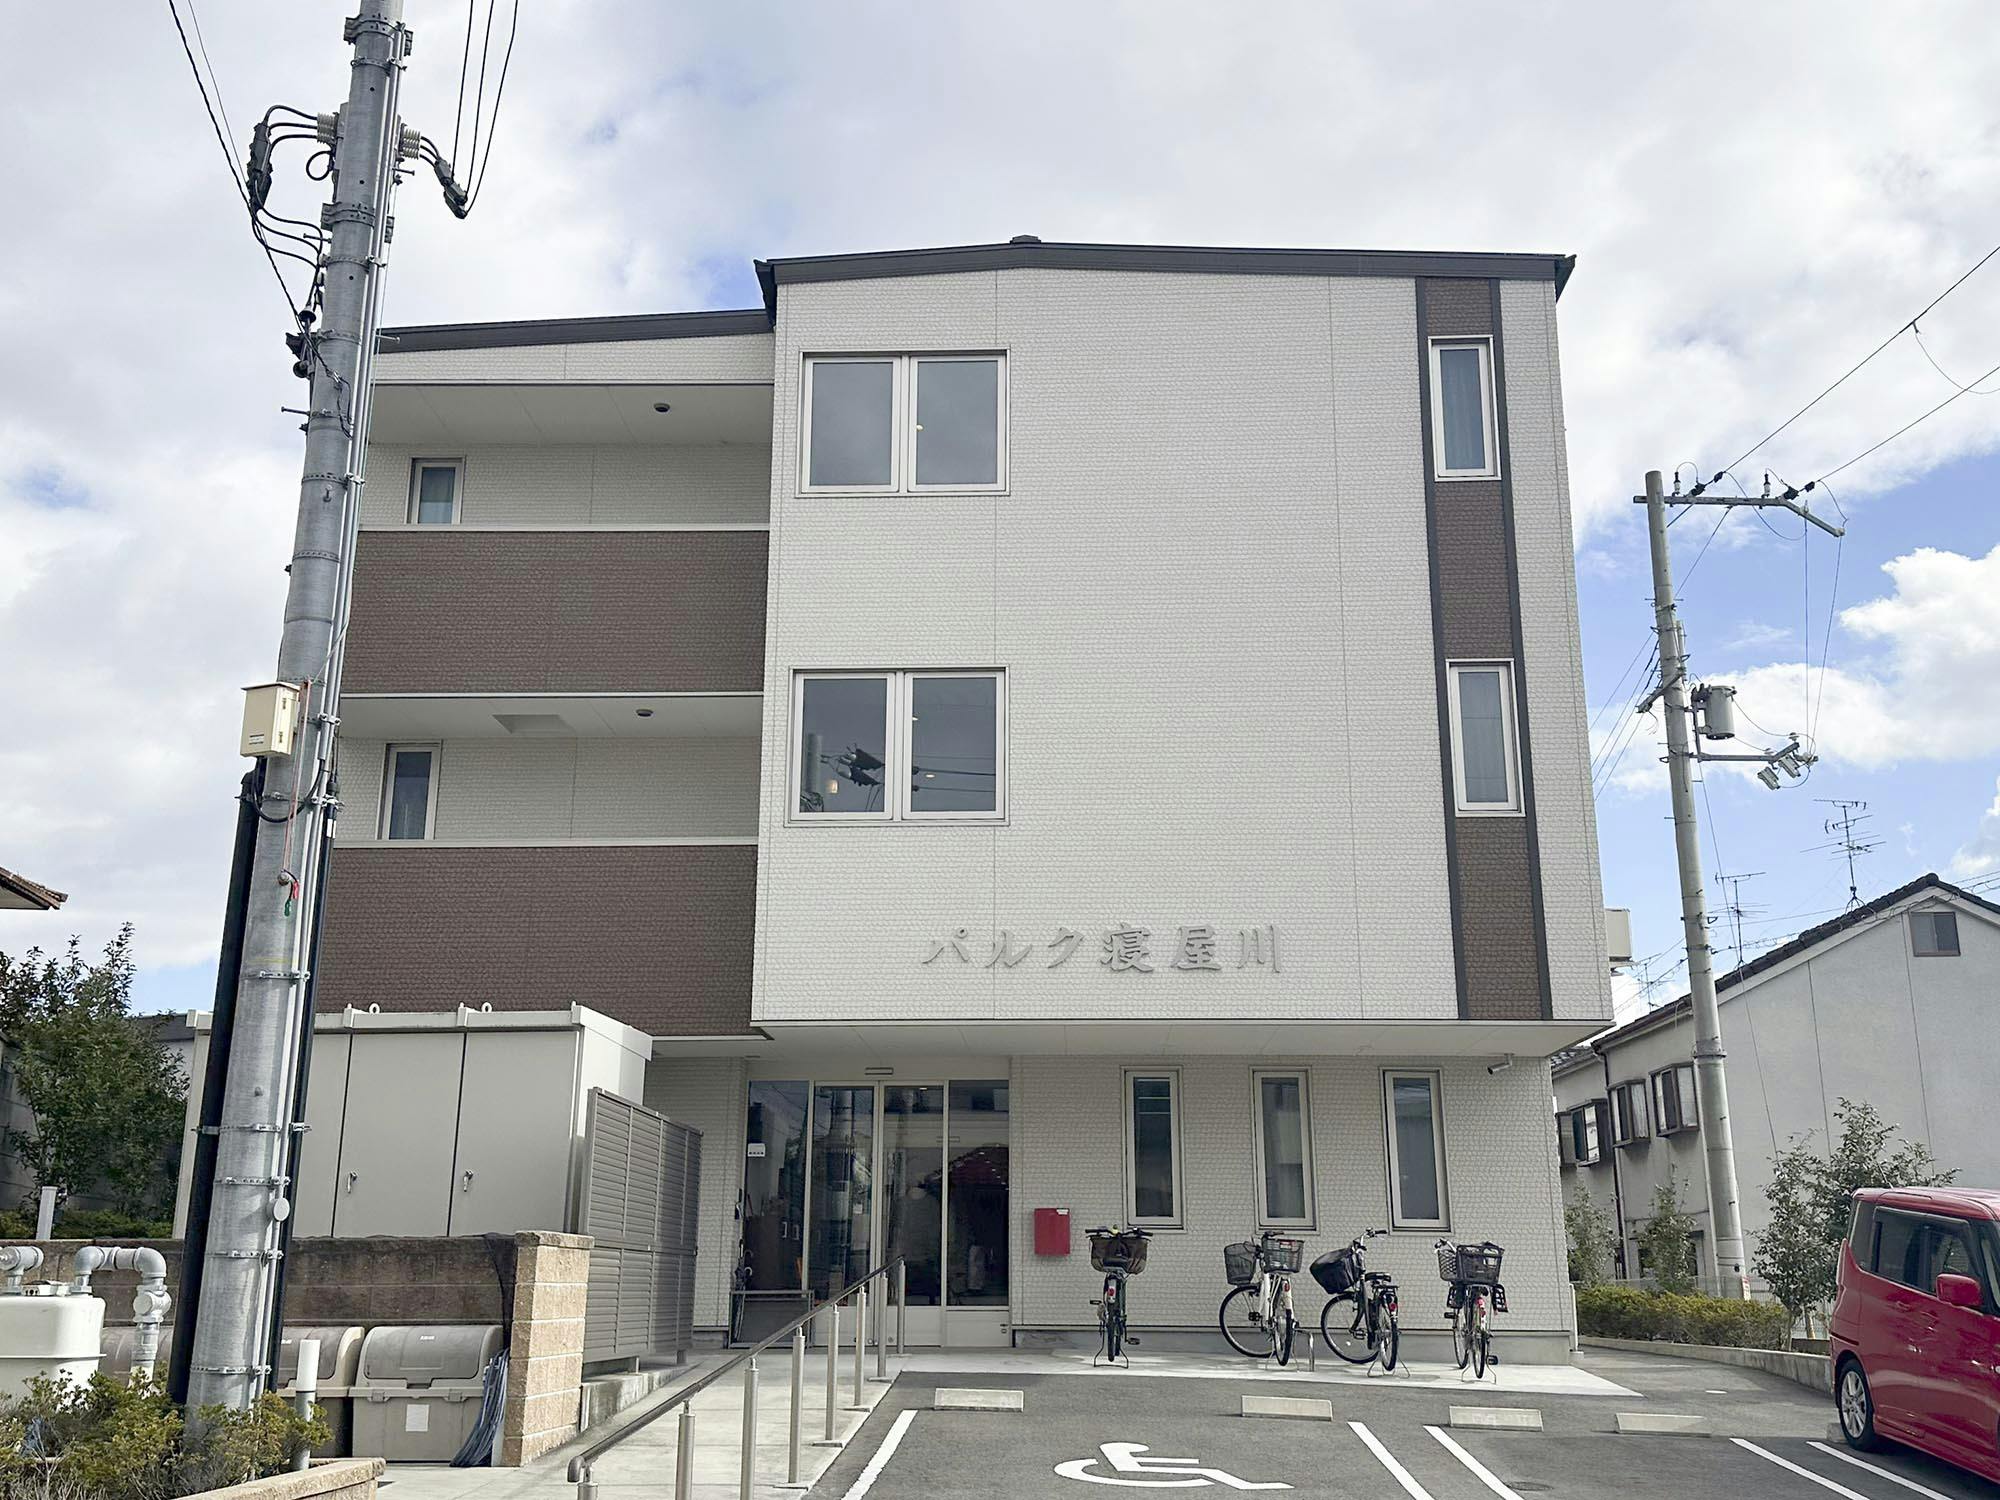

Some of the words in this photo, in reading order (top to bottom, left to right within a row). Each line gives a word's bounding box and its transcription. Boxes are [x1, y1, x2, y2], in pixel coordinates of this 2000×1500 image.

[922, 923, 1280, 974] パルク寝屋川
